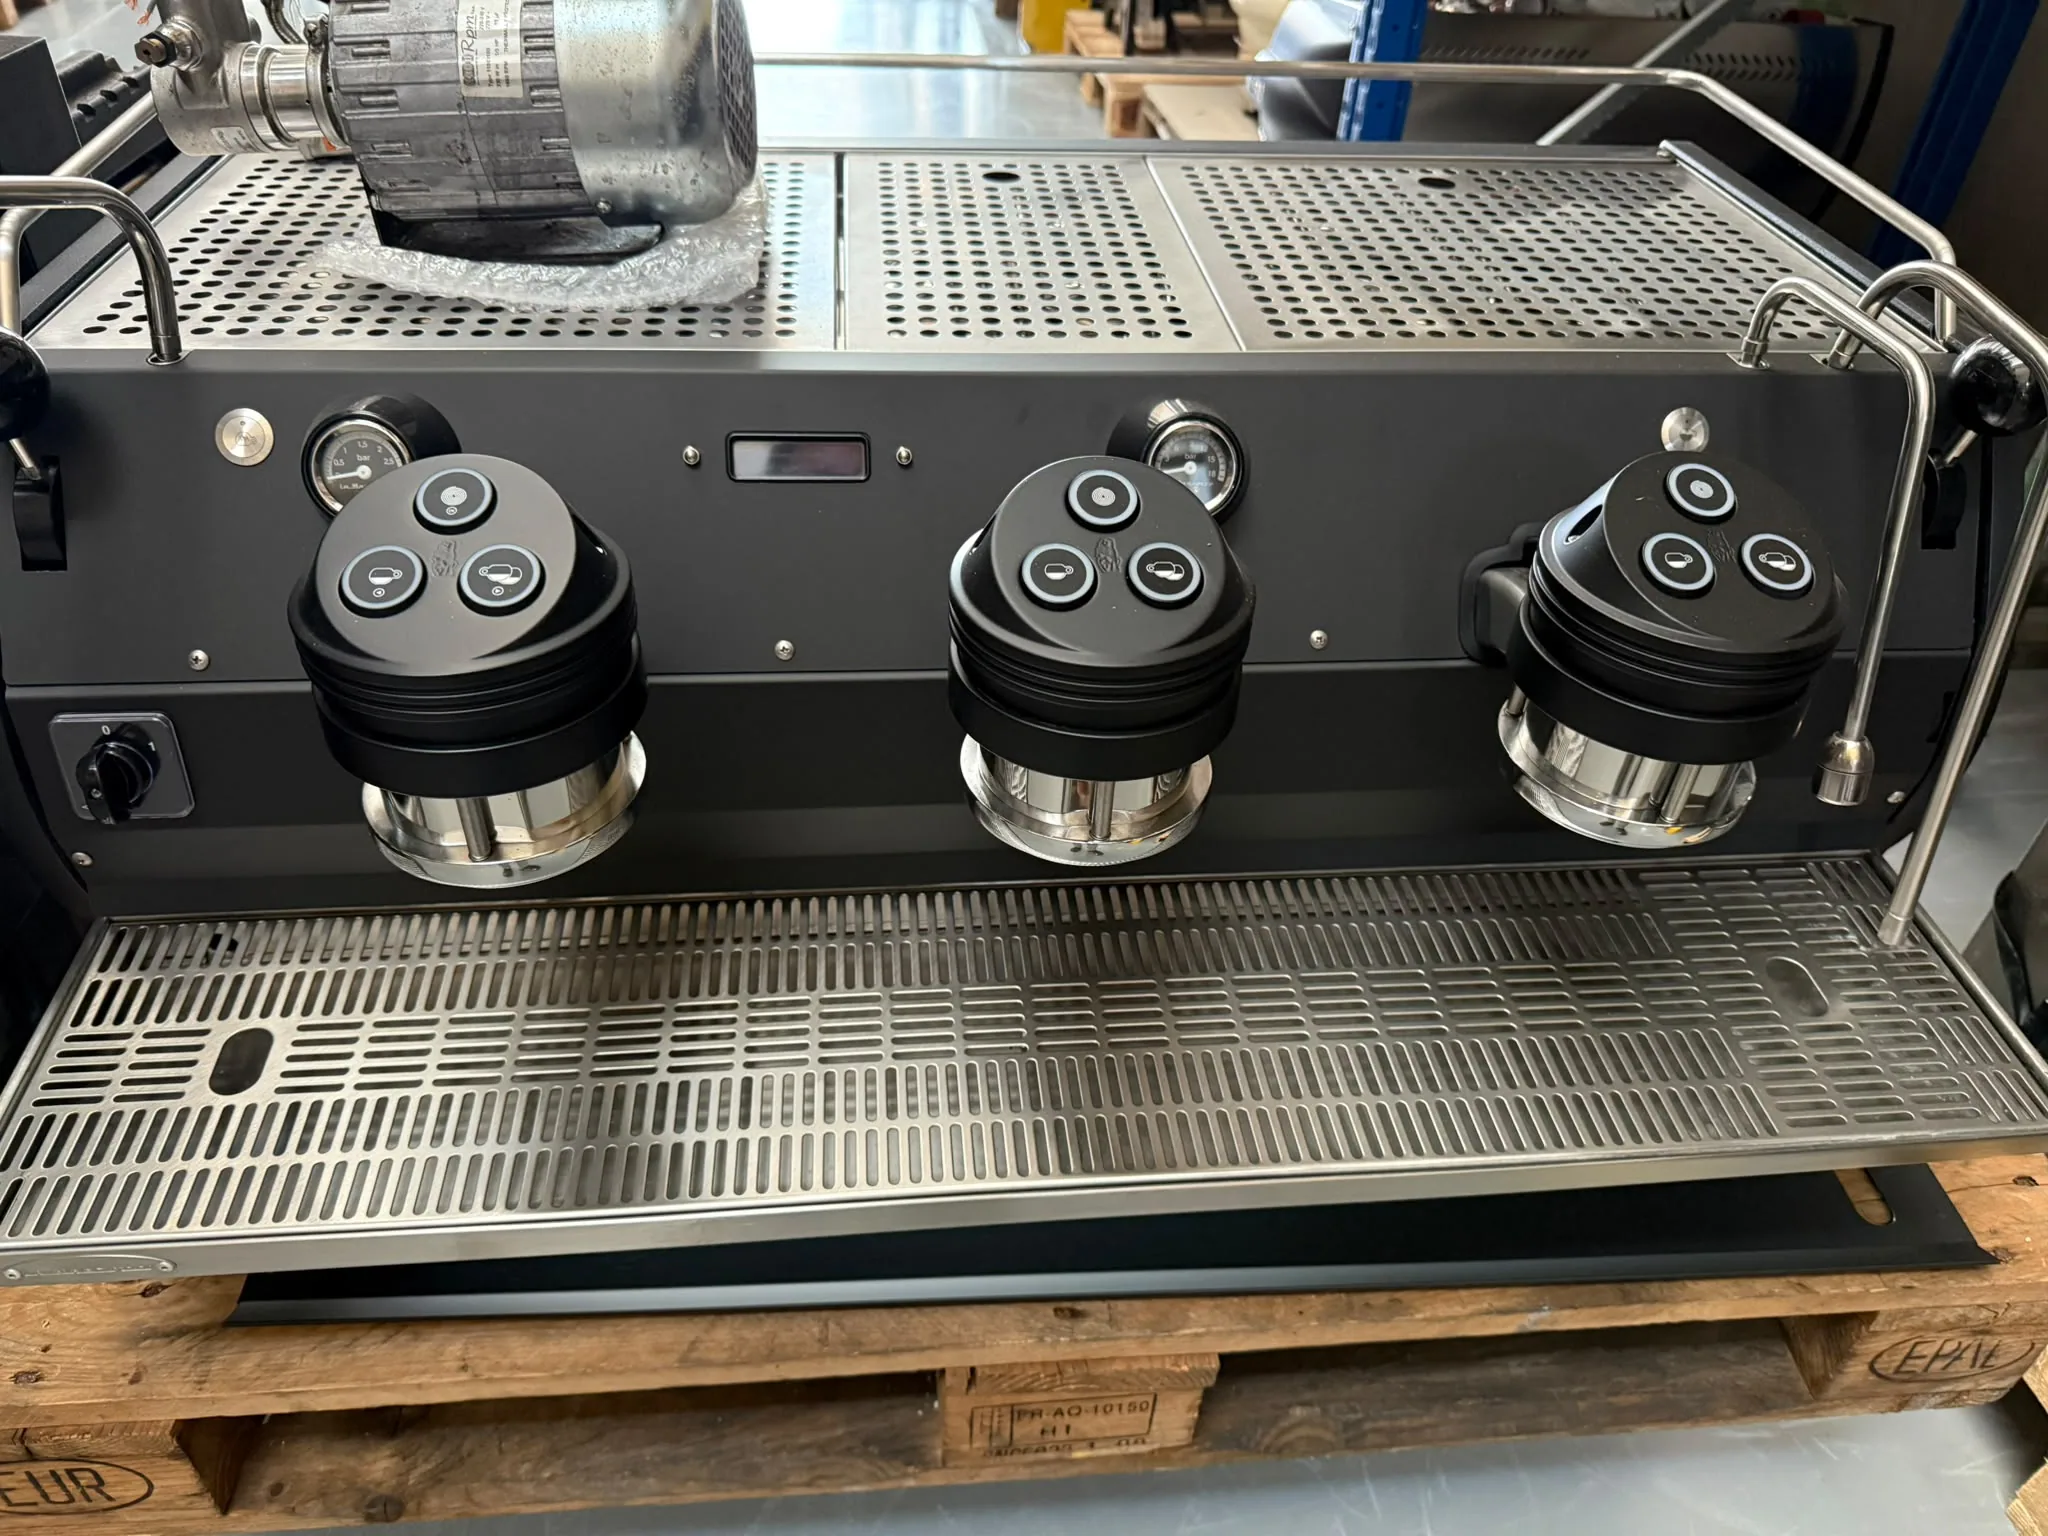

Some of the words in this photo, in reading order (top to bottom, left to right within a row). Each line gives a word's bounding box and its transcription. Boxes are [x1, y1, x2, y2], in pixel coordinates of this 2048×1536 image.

[356, 453, 370, 461] bar
[1207, 455, 1216, 463] 15
[101, 725, 111, 735] 0
[148, 741, 156, 751] 1
[0, 1467, 117, 1508] EUR
